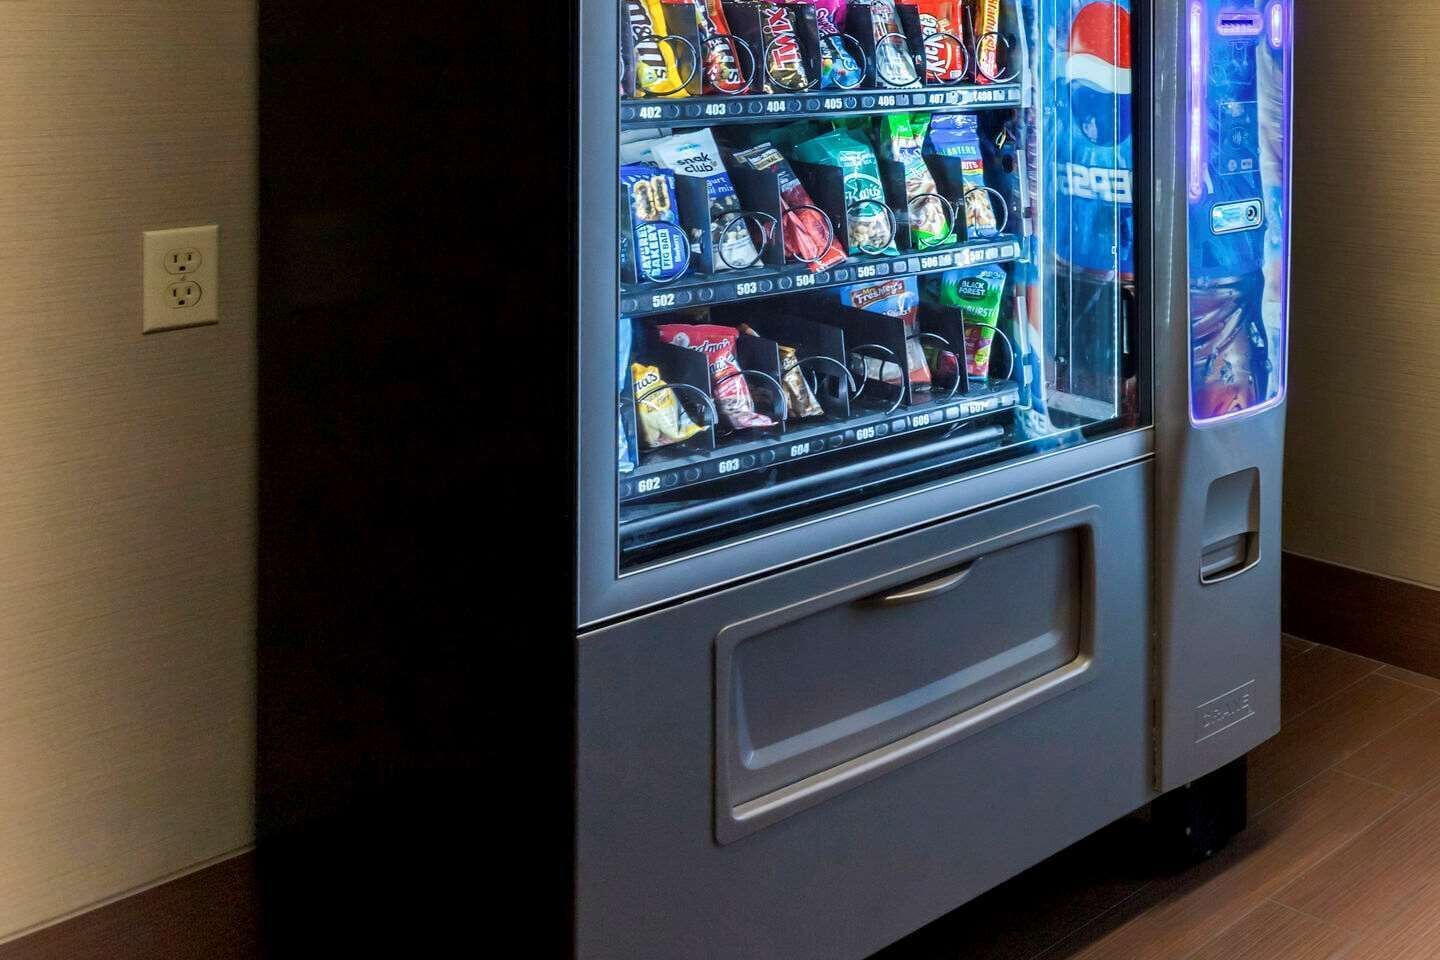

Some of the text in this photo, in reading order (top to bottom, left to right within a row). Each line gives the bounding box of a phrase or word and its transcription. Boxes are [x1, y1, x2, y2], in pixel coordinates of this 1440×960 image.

[767, 7, 802, 71] TWIX
[824, 98, 843, 110] 405
[878, 95, 895, 107] 406
[929, 93, 944, 105] 407
[640, 106, 662, 119] 402
[705, 103, 726, 115] 403
[767, 100, 786, 112] 404
[677, 151, 712, 165] snak
[684, 162, 714, 173] club
[921, 257, 938, 269] 506
[857, 264, 876, 278] 505
[796, 274, 815, 287] 504
[961, 280, 985, 289] BLACK
[736, 282, 758, 296] 503
[958, 287, 986, 296] FOREST
[652, 293, 675, 308] 502
[912, 413, 930, 426] 606
[856, 426, 875, 440] 605
[790, 443, 811, 457] 604
[719, 458, 740, 474] 603
[638, 477, 661, 493] 602
